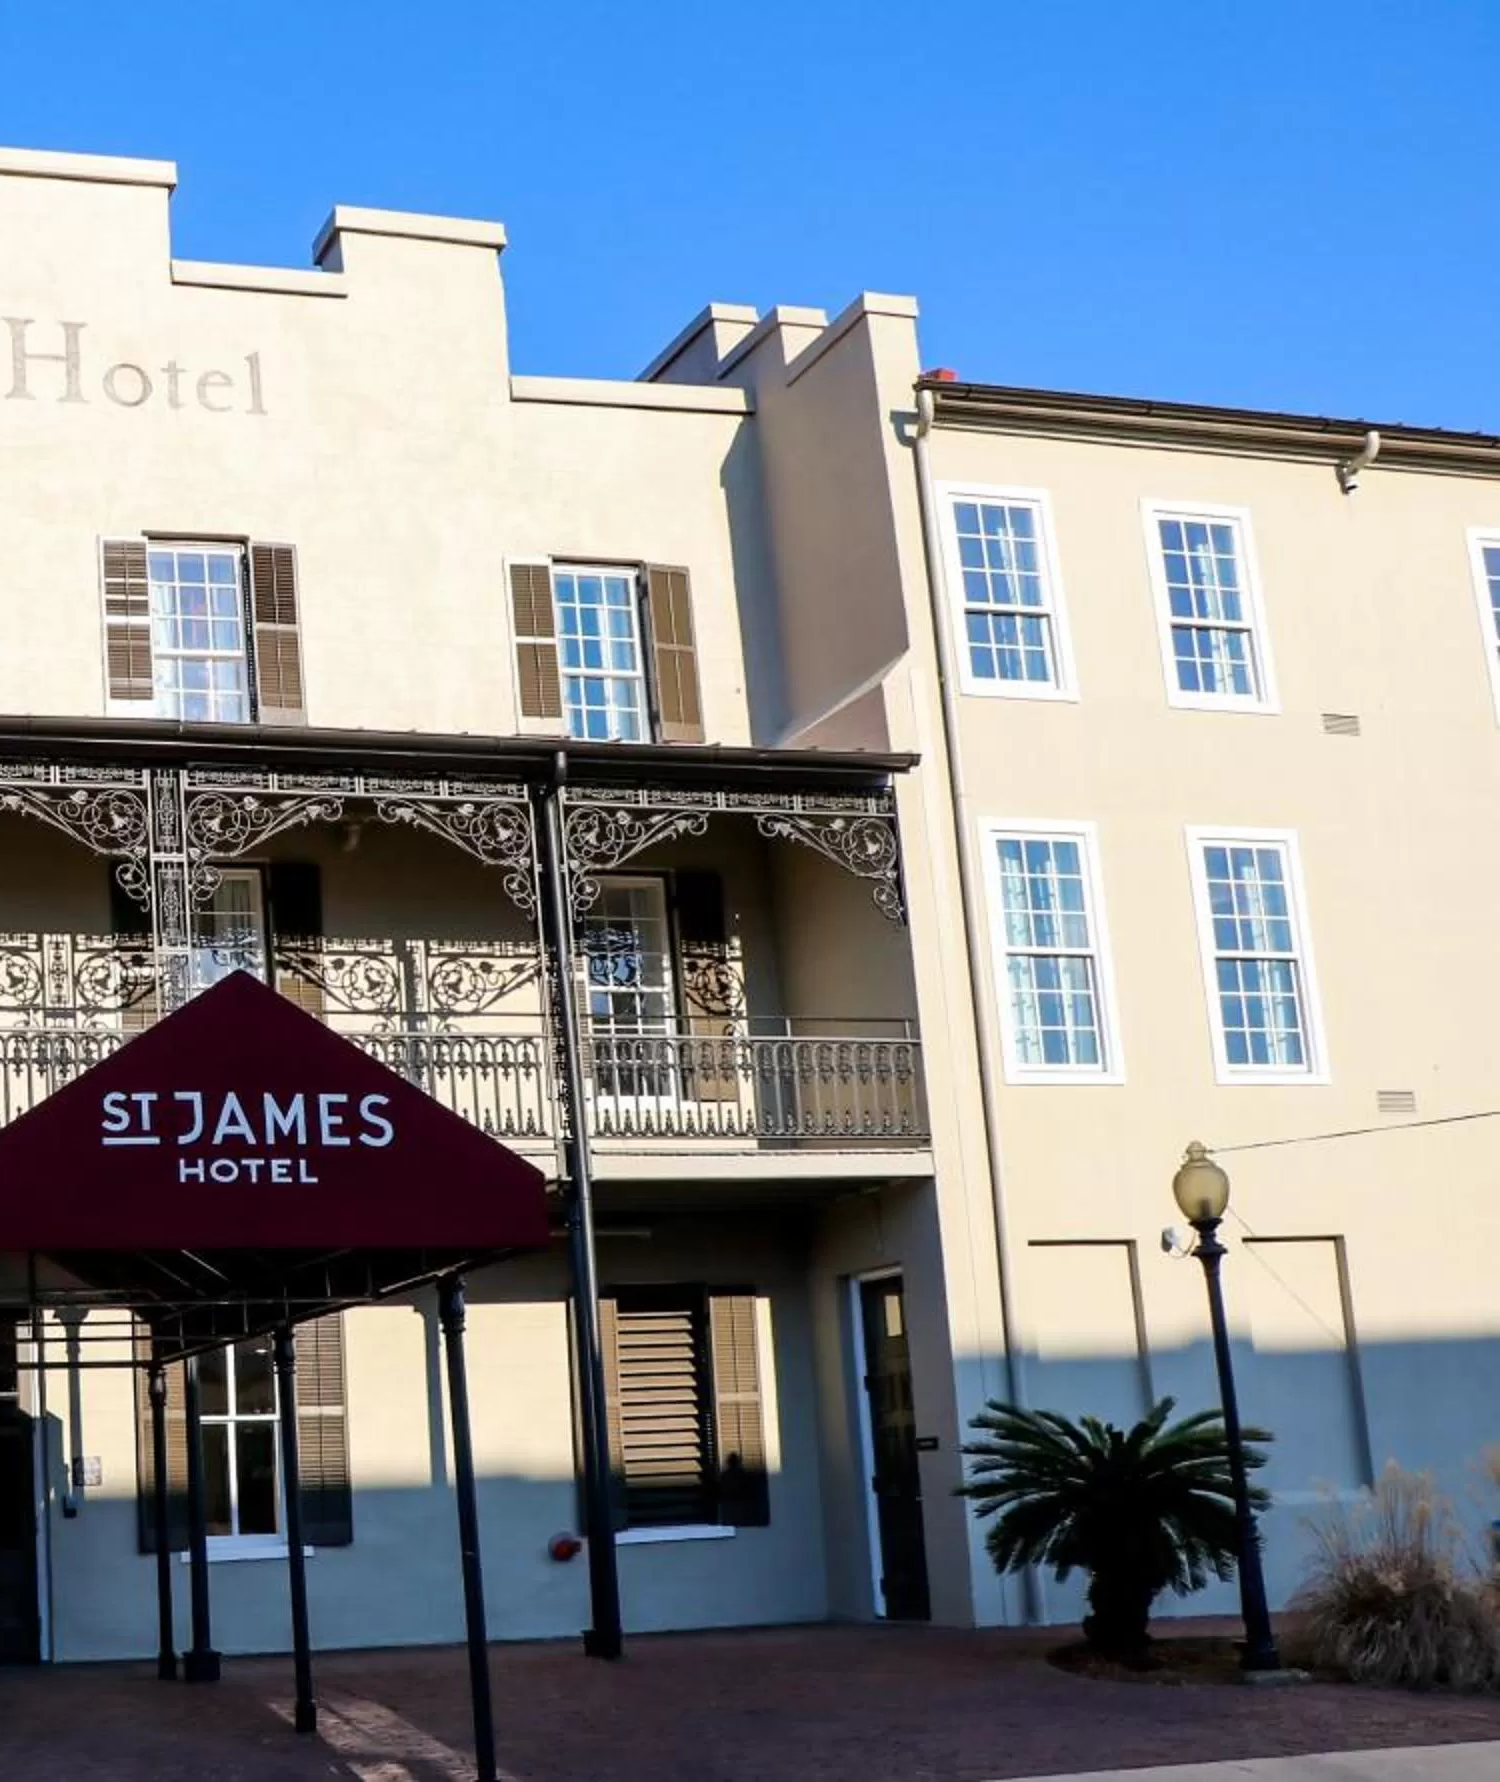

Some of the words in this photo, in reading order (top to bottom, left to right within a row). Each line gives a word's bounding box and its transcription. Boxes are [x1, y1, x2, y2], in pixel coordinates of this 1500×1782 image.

[1, 315, 269, 416] Hotel
[101, 1091, 160, 1145] ST
[173, 1091, 394, 1147] JAMES
[179, 1158, 319, 1184] HOTEL
